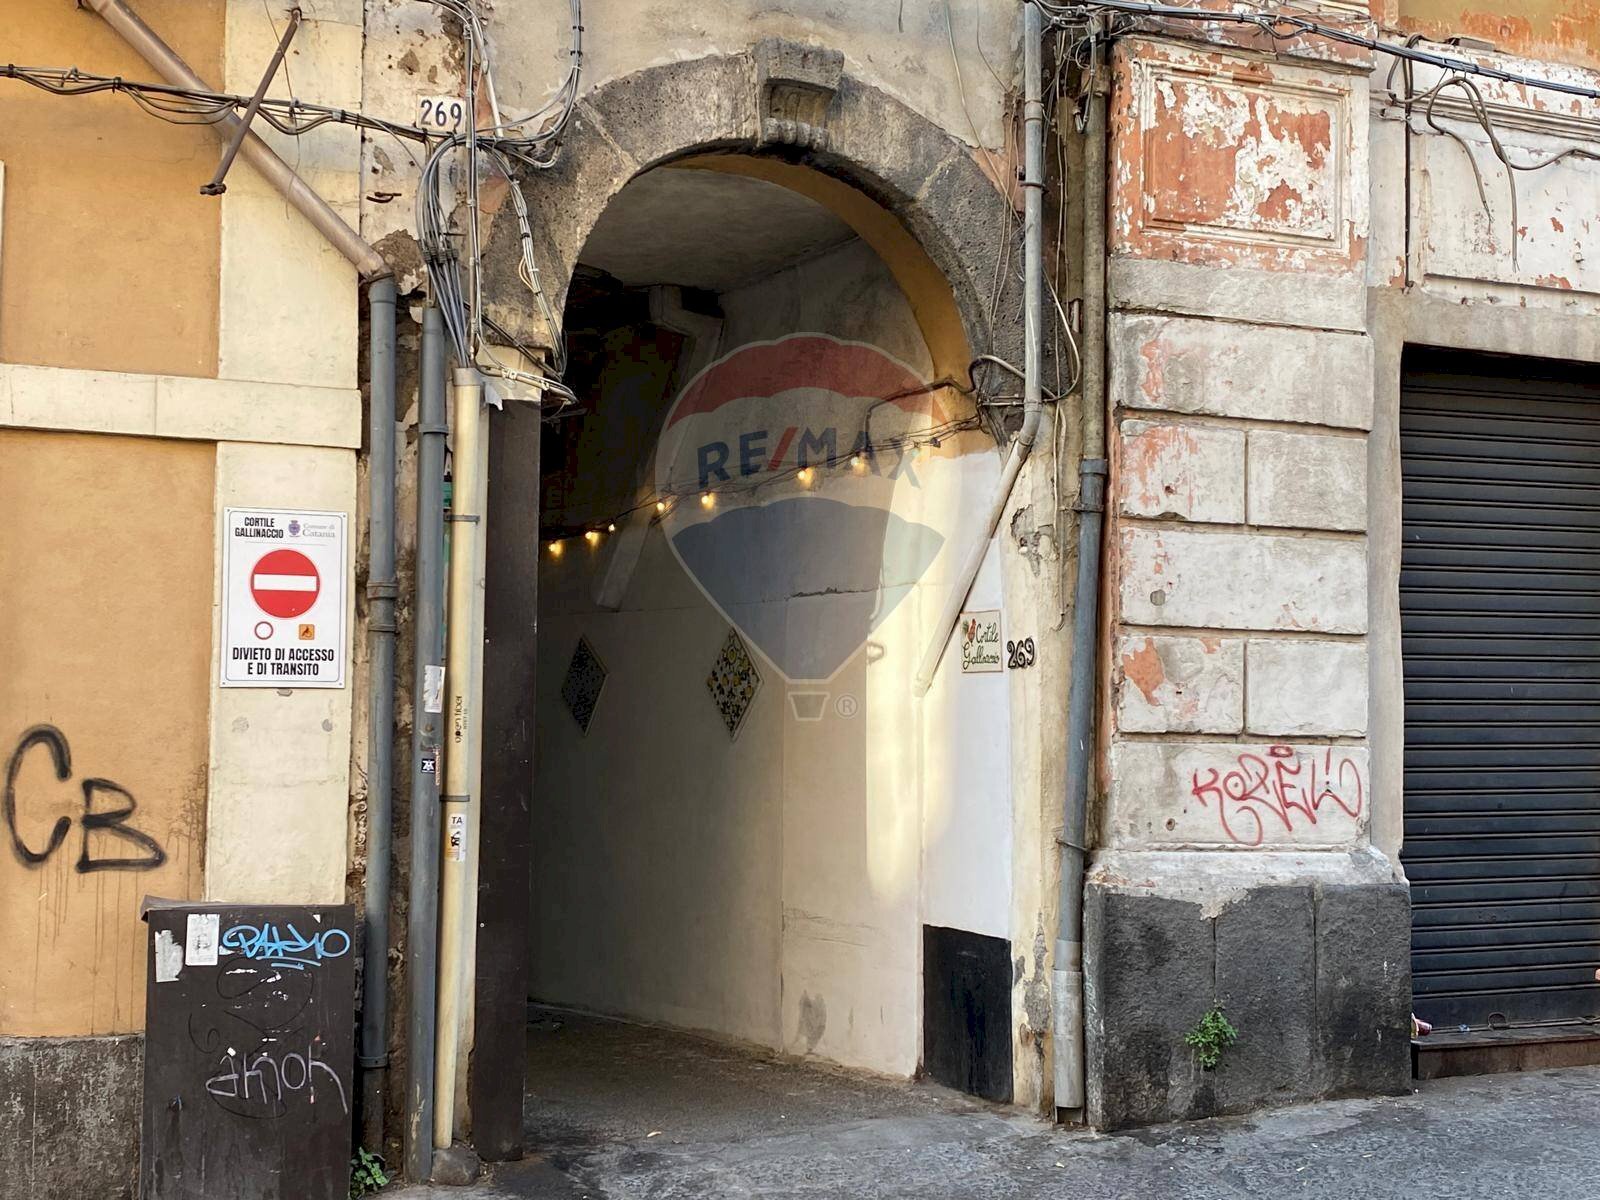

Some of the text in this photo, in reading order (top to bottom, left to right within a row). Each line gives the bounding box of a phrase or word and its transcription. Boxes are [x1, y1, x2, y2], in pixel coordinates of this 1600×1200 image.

[420, 99, 462, 127] 269
[244, 516, 275, 527] CORTILE
[234, 527, 284, 539] GALLINACCIO
[302, 529, 336, 538] Catania
[232, 647, 335, 662] DIVIETO DI ACCESSO
[1006, 636, 1035, 669] 269
[246, 662, 320, 677] E DI TRANSITO
